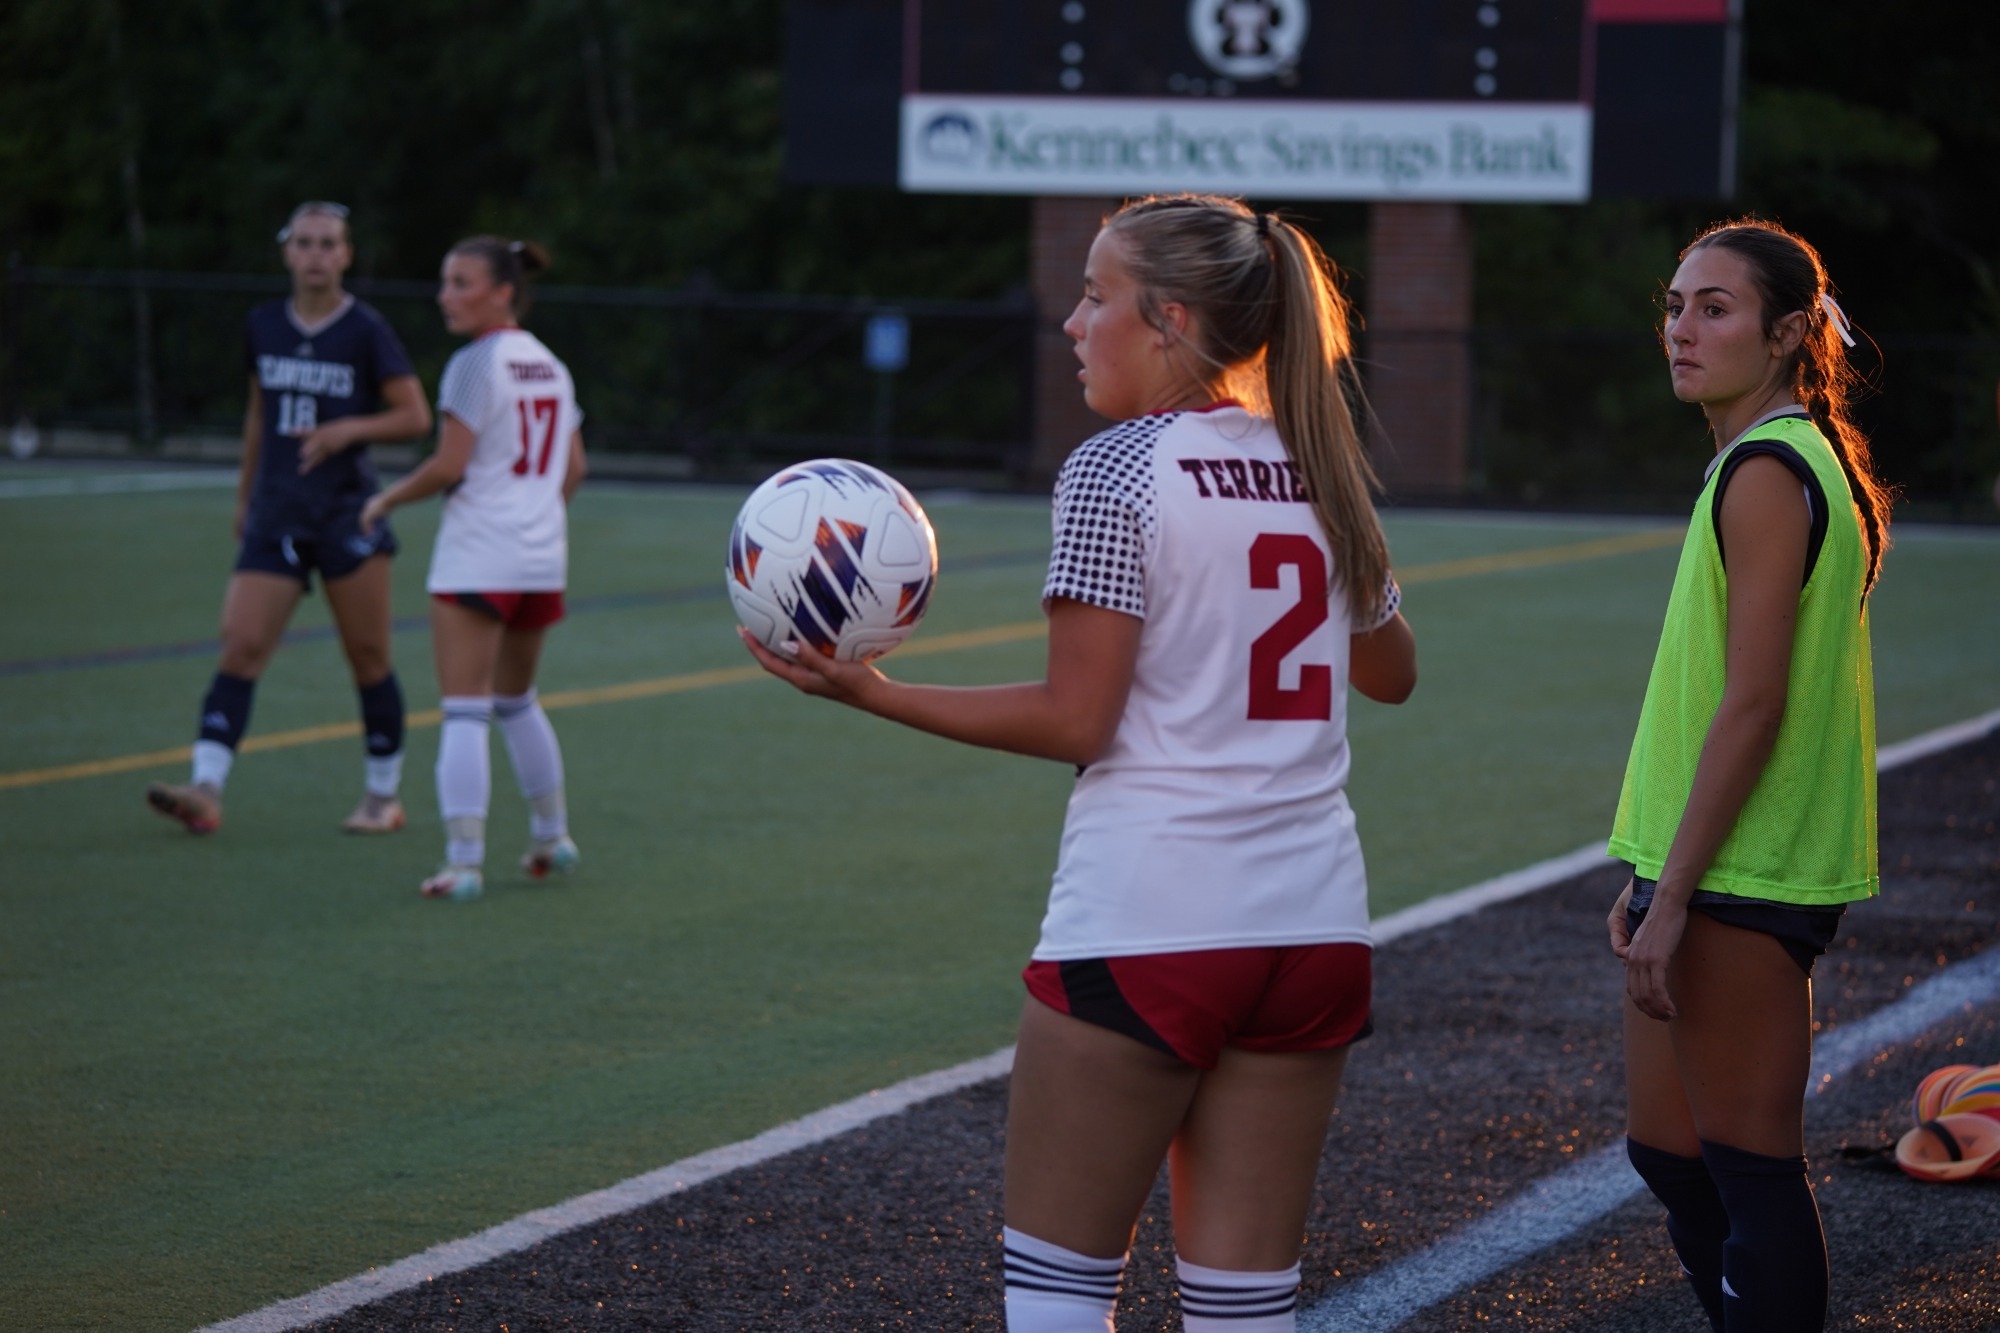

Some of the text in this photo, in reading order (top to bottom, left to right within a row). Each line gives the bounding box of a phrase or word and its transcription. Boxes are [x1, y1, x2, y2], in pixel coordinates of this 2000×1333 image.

[989, 108, 1571, 190] Kennebec Savings Bank
[511, 398, 560, 476] 17
[1177, 458, 1318, 503] TERRIE
[1247, 533, 1331, 721] 2
